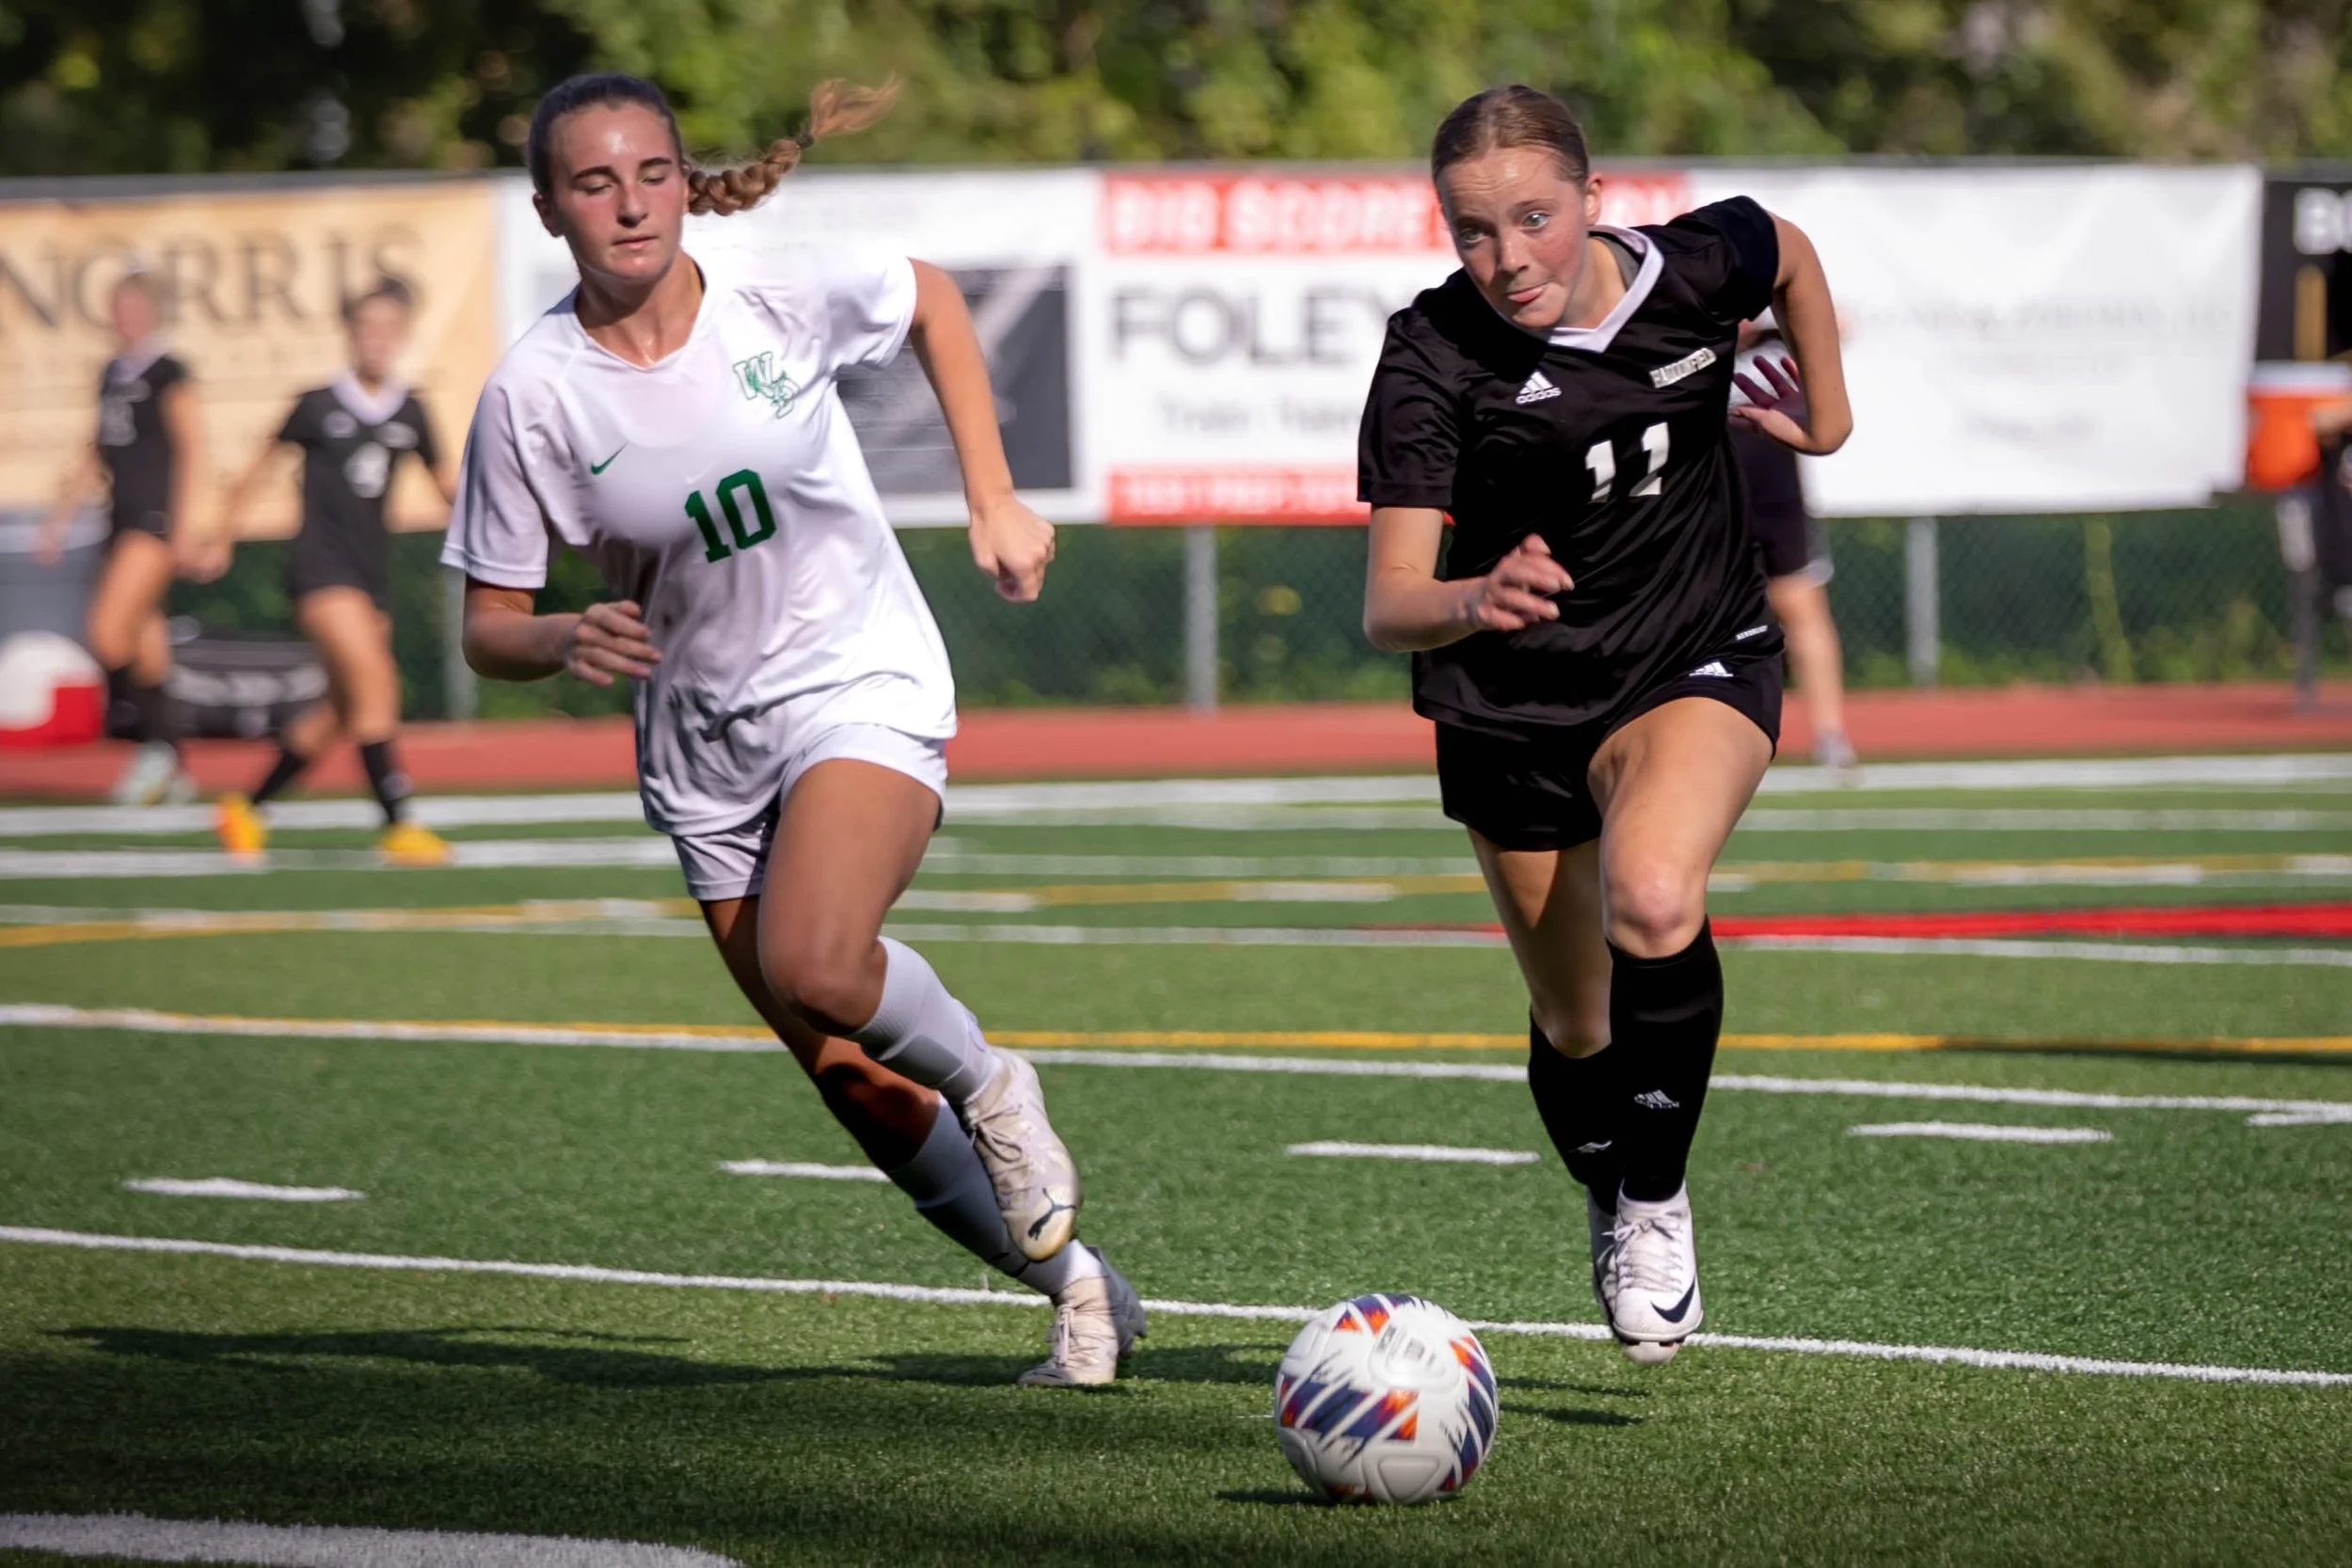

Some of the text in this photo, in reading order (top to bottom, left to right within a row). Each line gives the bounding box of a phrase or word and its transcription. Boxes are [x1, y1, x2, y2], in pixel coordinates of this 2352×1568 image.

[1516, 387, 1562, 404] adidas
[1585, 422, 1670, 502] 11
[685, 468, 777, 563] 10
